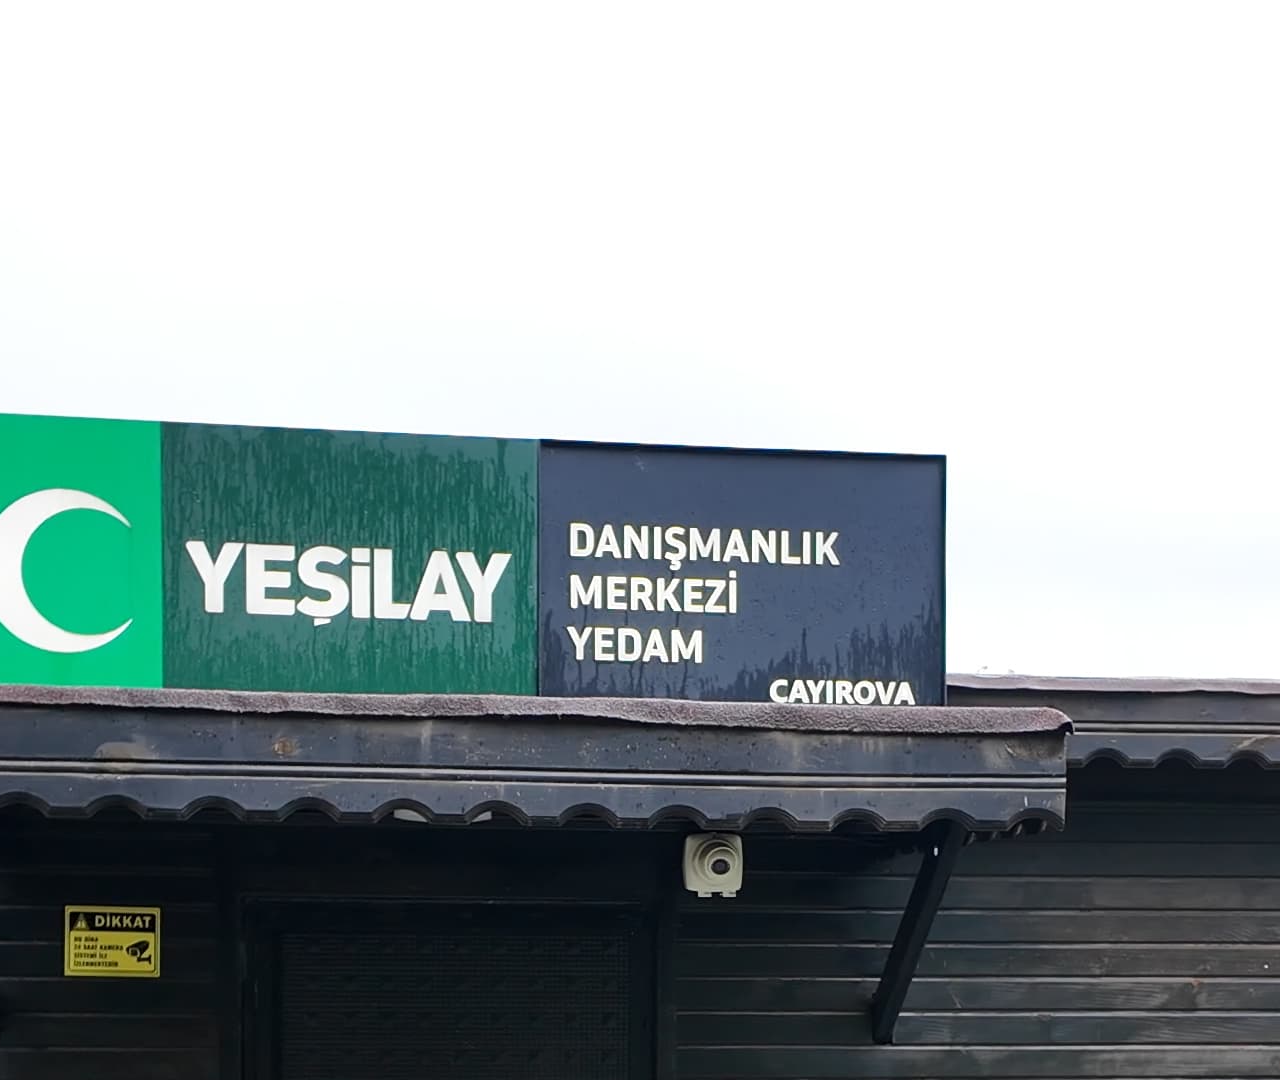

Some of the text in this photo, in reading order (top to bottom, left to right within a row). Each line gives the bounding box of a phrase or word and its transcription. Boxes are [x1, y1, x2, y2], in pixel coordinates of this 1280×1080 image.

[569, 522, 841, 571] DANIŞMANLIK
[569, 570, 738, 614] MERKEZİ
[566, 626, 703, 664] YEDAM
[94, 912, 152, 929] DİKKAT
